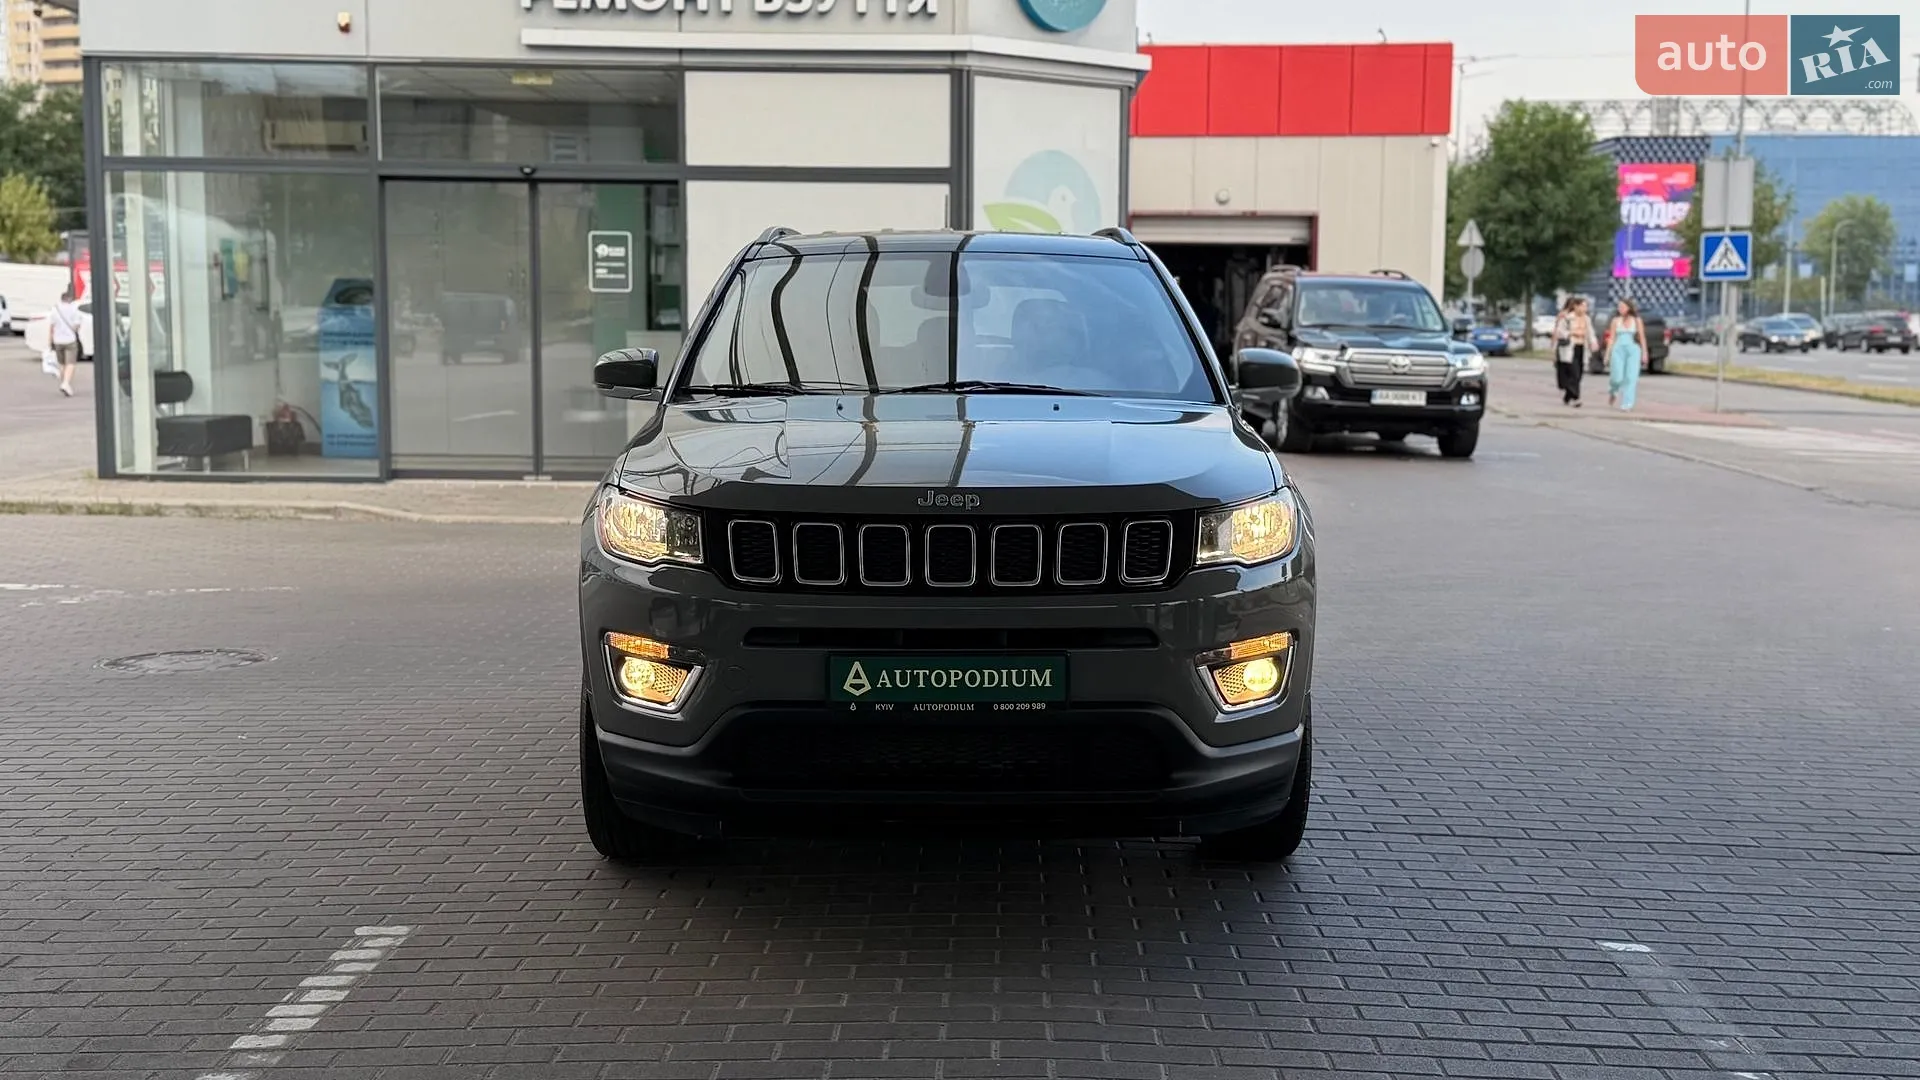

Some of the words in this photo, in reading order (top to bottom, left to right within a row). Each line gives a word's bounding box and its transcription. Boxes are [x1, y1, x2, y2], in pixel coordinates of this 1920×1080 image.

[917, 489, 980, 510] Jeep
[876, 668, 1053, 688] AUTOPODIUM
[875, 703, 894, 711] KYIV
[913, 703, 975, 711] AUTOPODIUM
[1015, 702, 1031, 710] 209
[1031, 702, 1046, 710] 989
